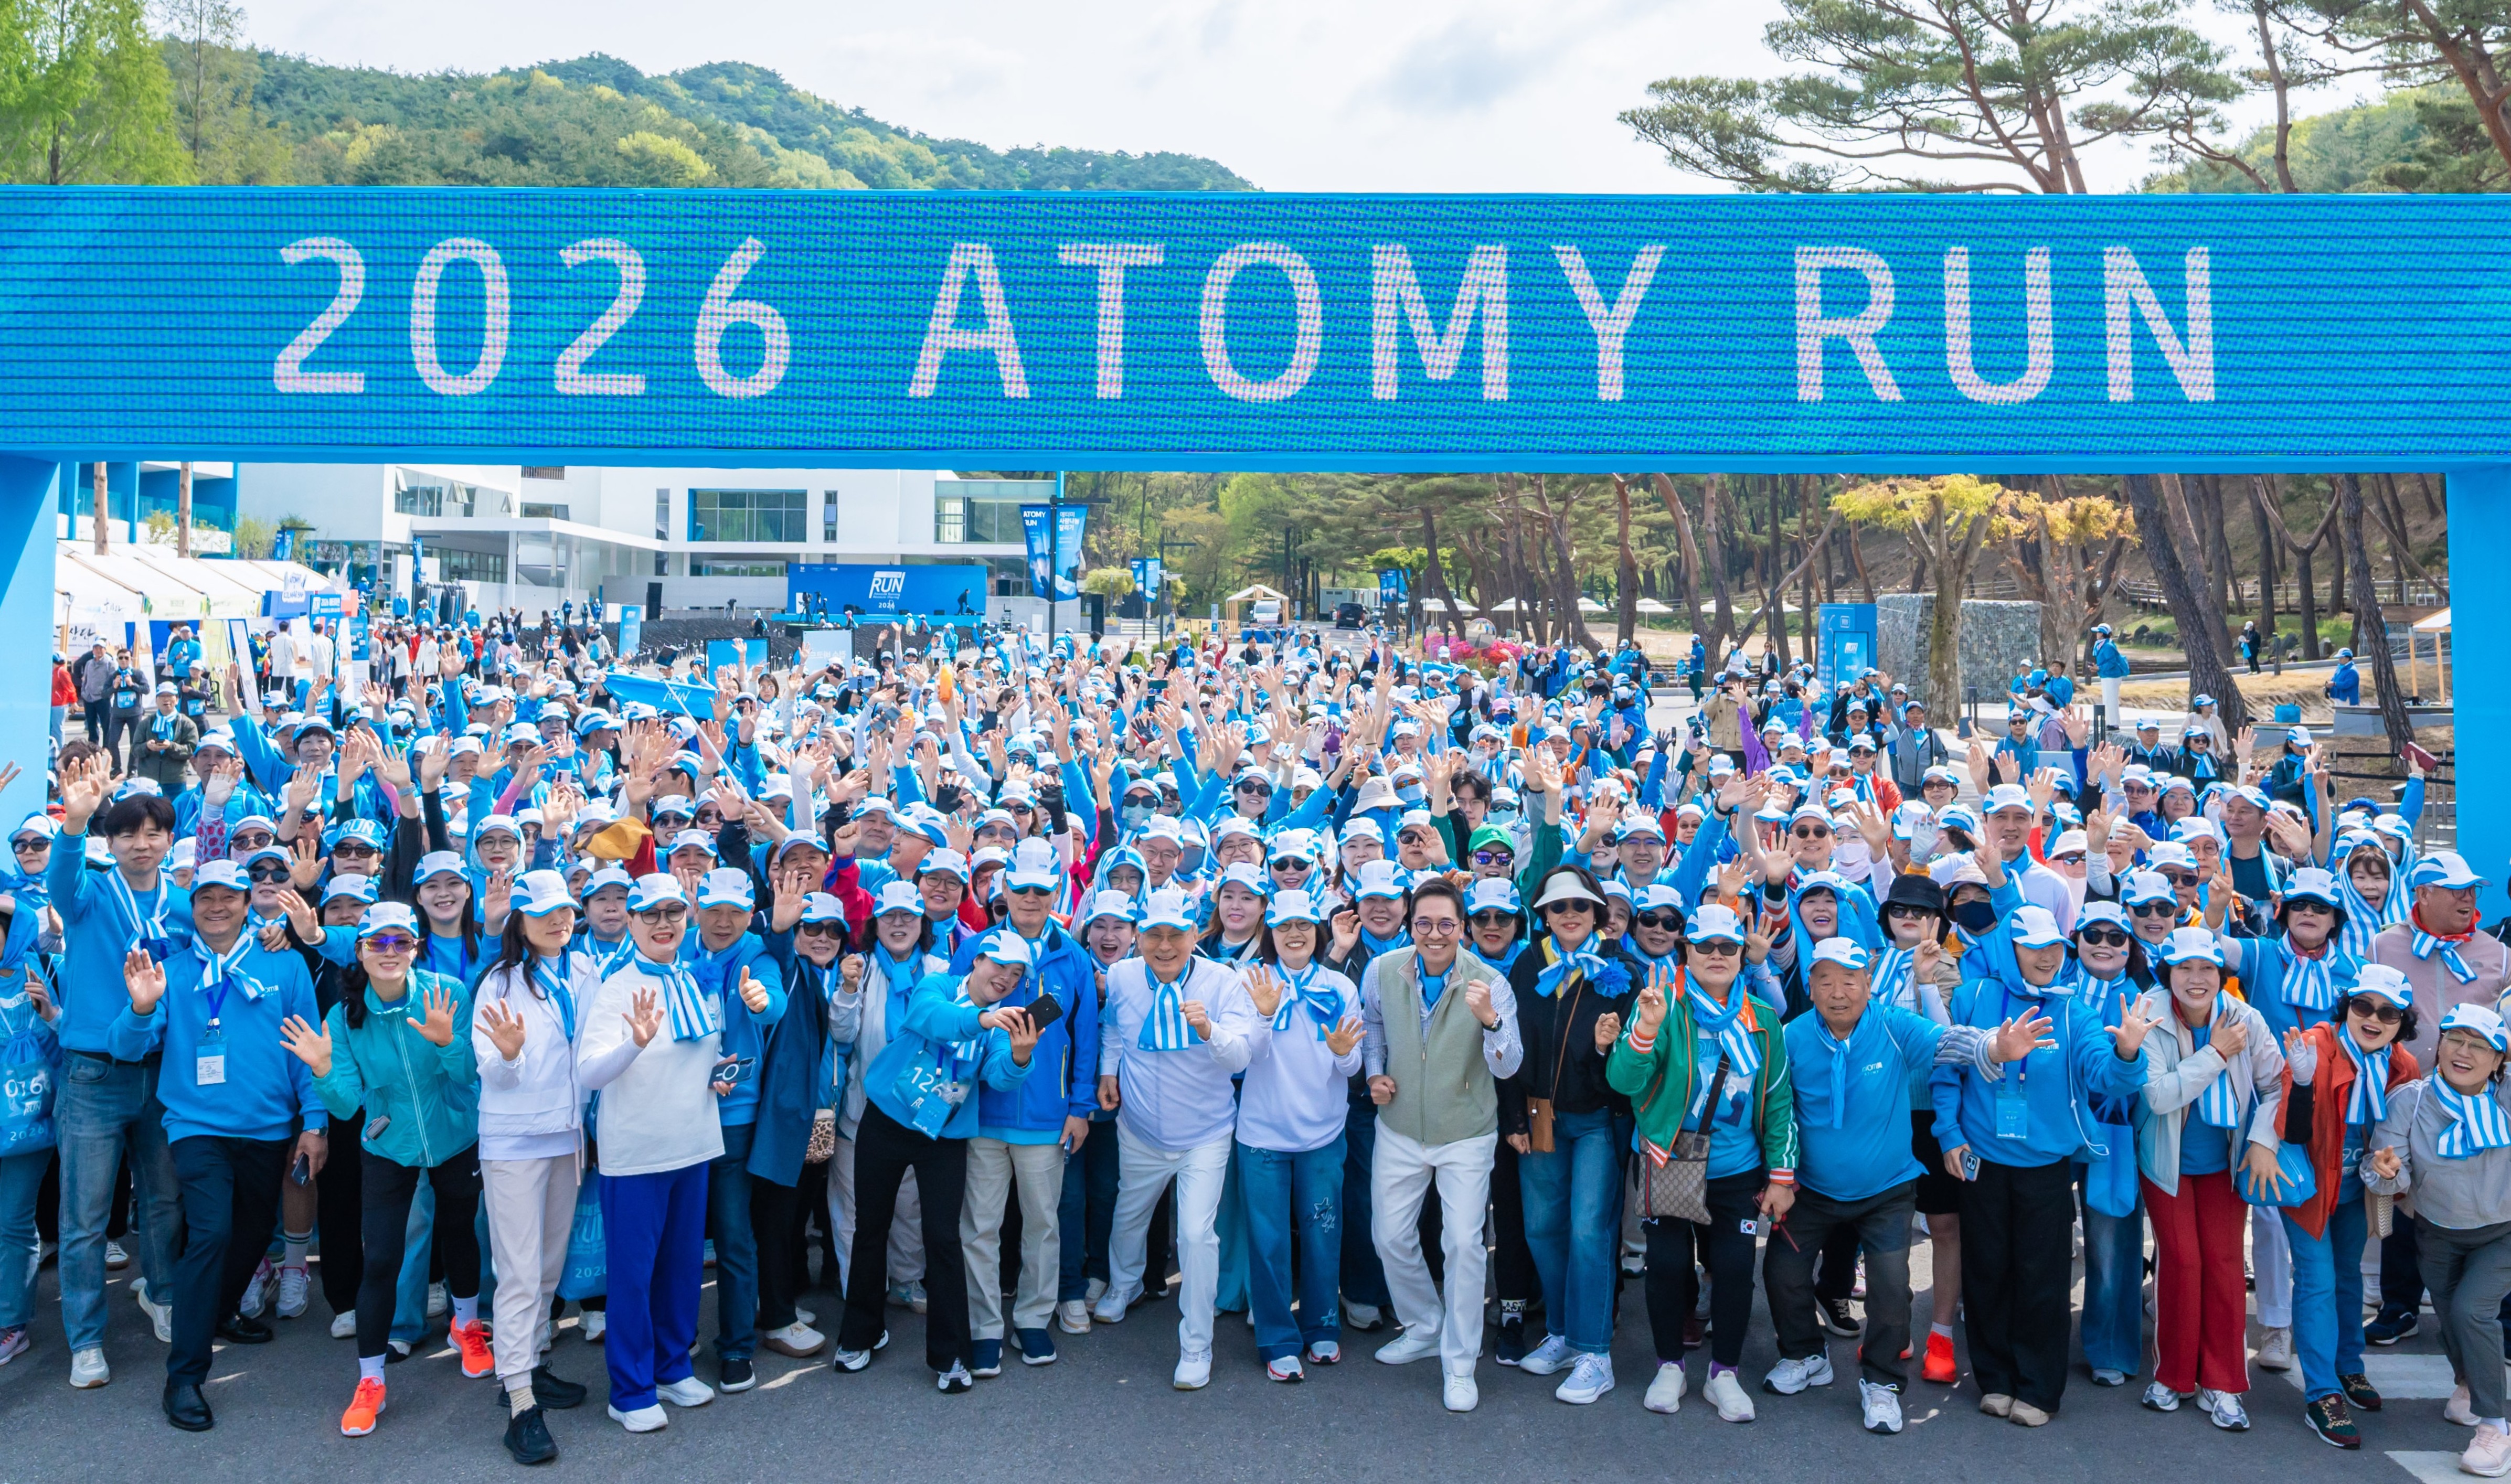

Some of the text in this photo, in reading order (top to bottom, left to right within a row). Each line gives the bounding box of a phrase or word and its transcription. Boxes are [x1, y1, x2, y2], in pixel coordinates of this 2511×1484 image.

[274, 237, 2215, 405] 2026 ATOMY RUN
[869, 571, 906, 599] RUN
[1845, 644, 1857, 653] RUN
[1382, 784, 1387, 792] B
[338, 818, 376, 839] RUN
[24, 1101, 41, 1116] RUN
[10, 1124, 45, 1141] 2026
